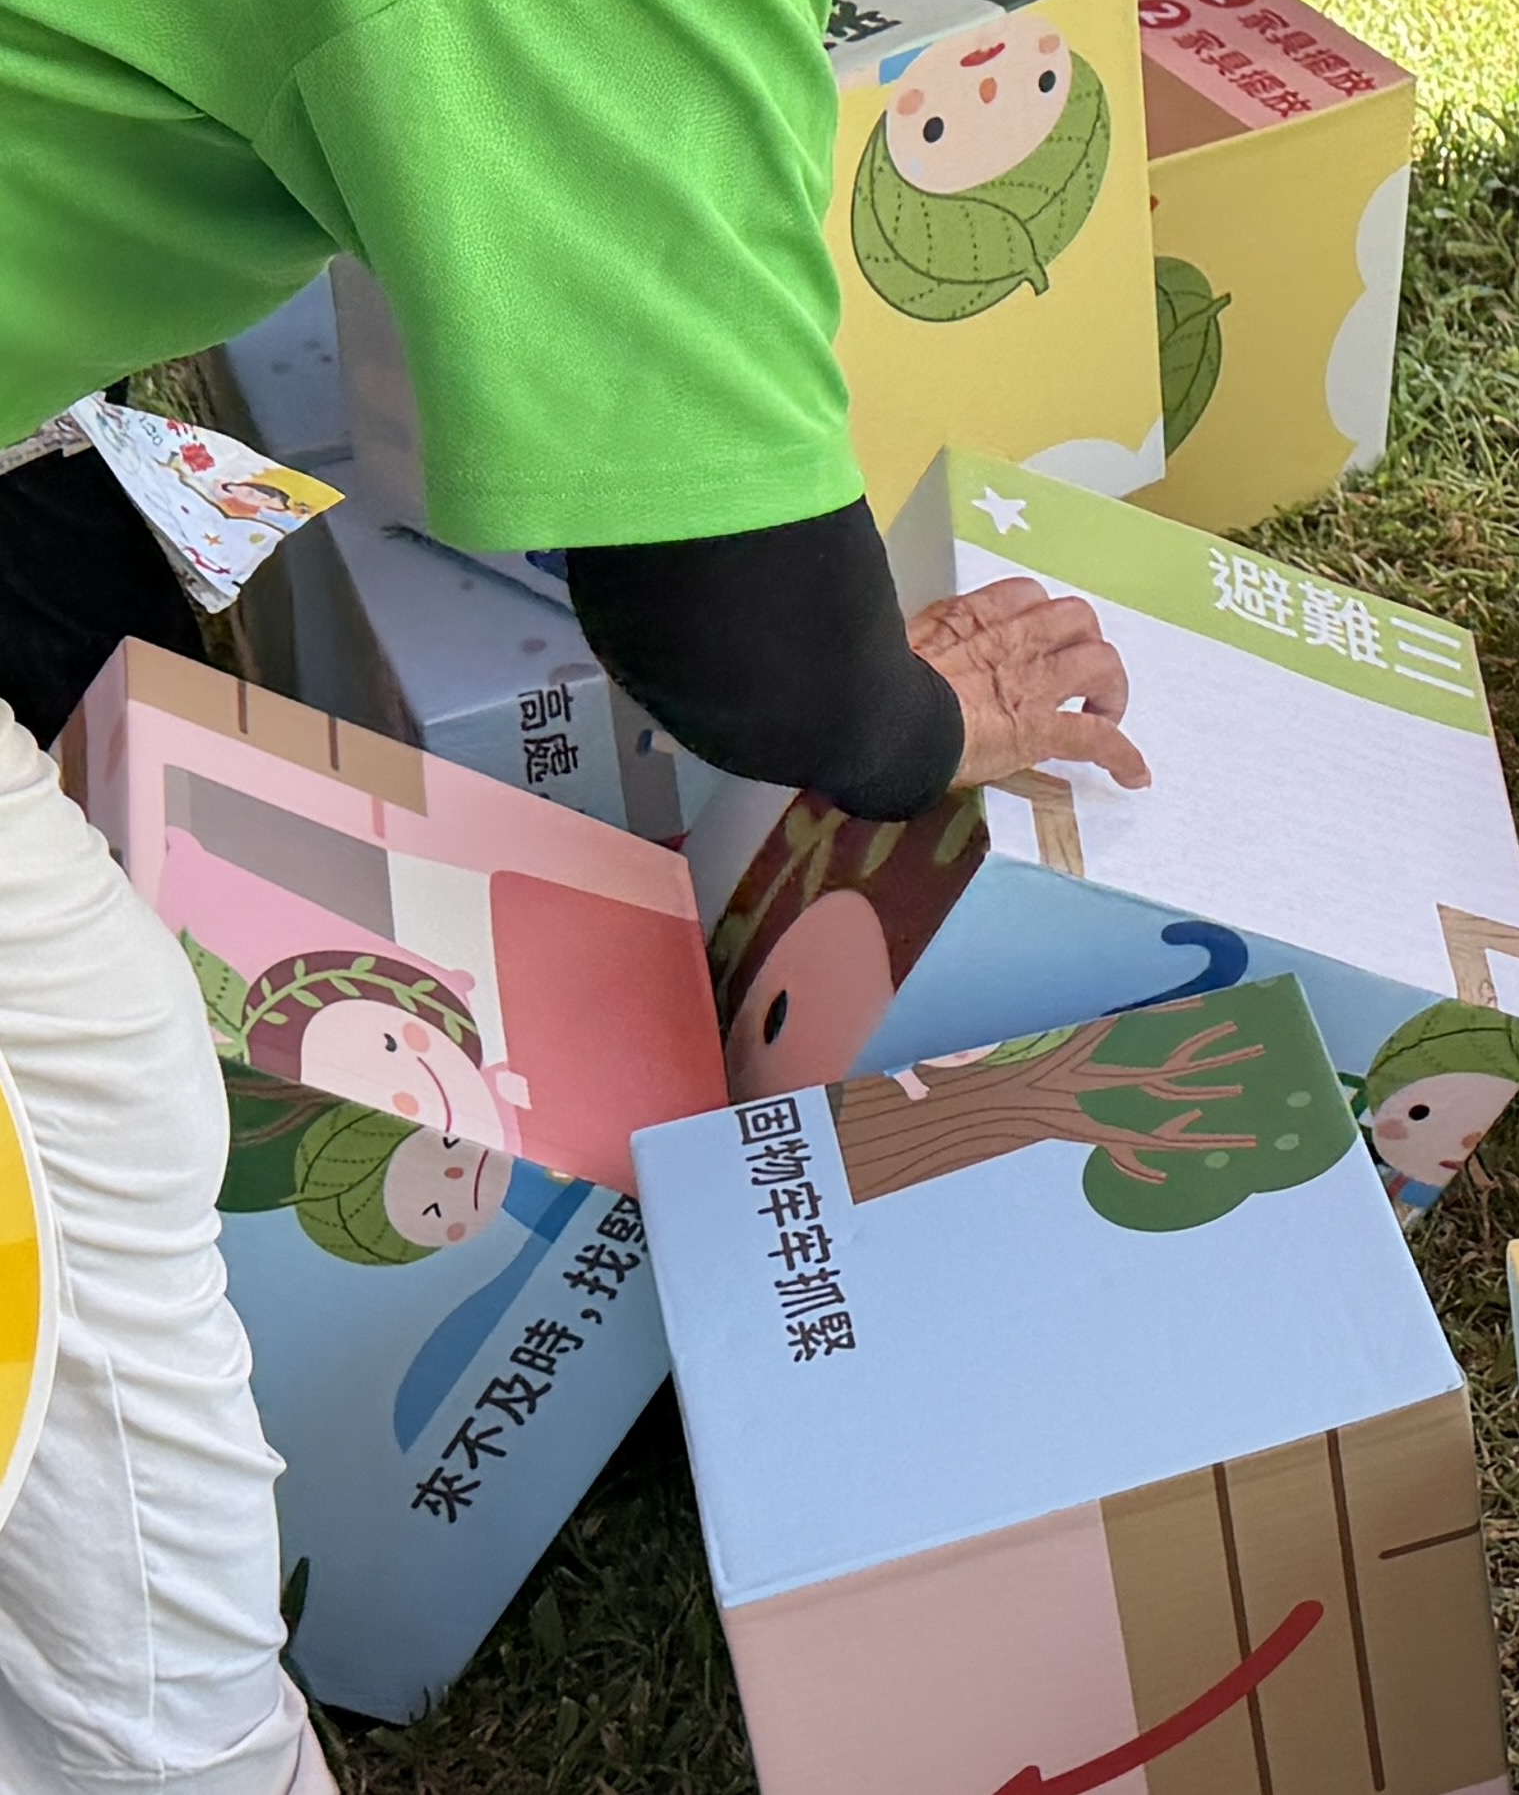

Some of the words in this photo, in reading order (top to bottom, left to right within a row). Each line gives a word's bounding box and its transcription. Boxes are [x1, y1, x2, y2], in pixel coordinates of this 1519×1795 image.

[735, 1096, 856, 1363] 固物牢牢抓緊
